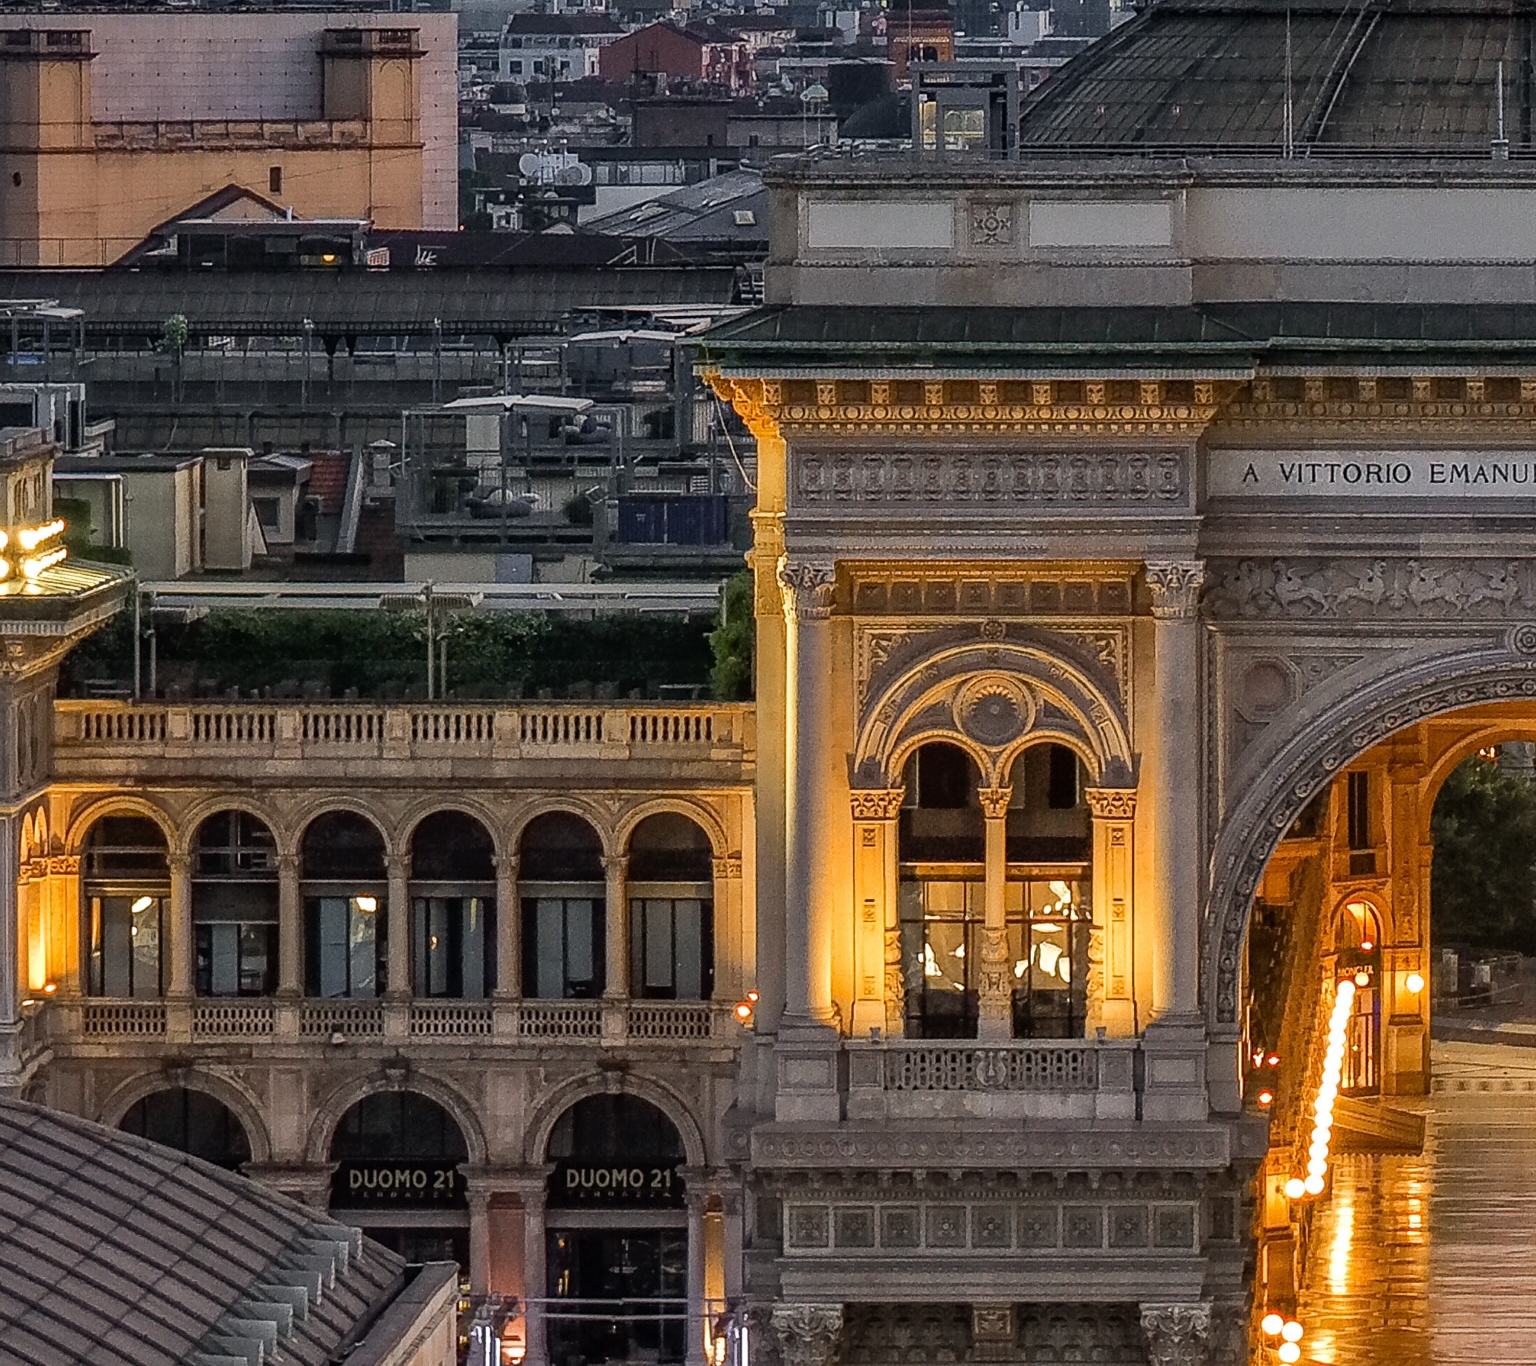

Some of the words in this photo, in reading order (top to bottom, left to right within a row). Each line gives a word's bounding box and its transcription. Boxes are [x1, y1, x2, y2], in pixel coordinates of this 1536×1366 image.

[1242, 463, 1260, 483] A
[1279, 463, 1412, 484] VITTORIO
[350, 1169, 428, 1189] DUOMO
[433, 1170, 455, 1188] 21
[566, 1168, 645, 1188] DUOMO
[650, 1169, 672, 1188] 21
